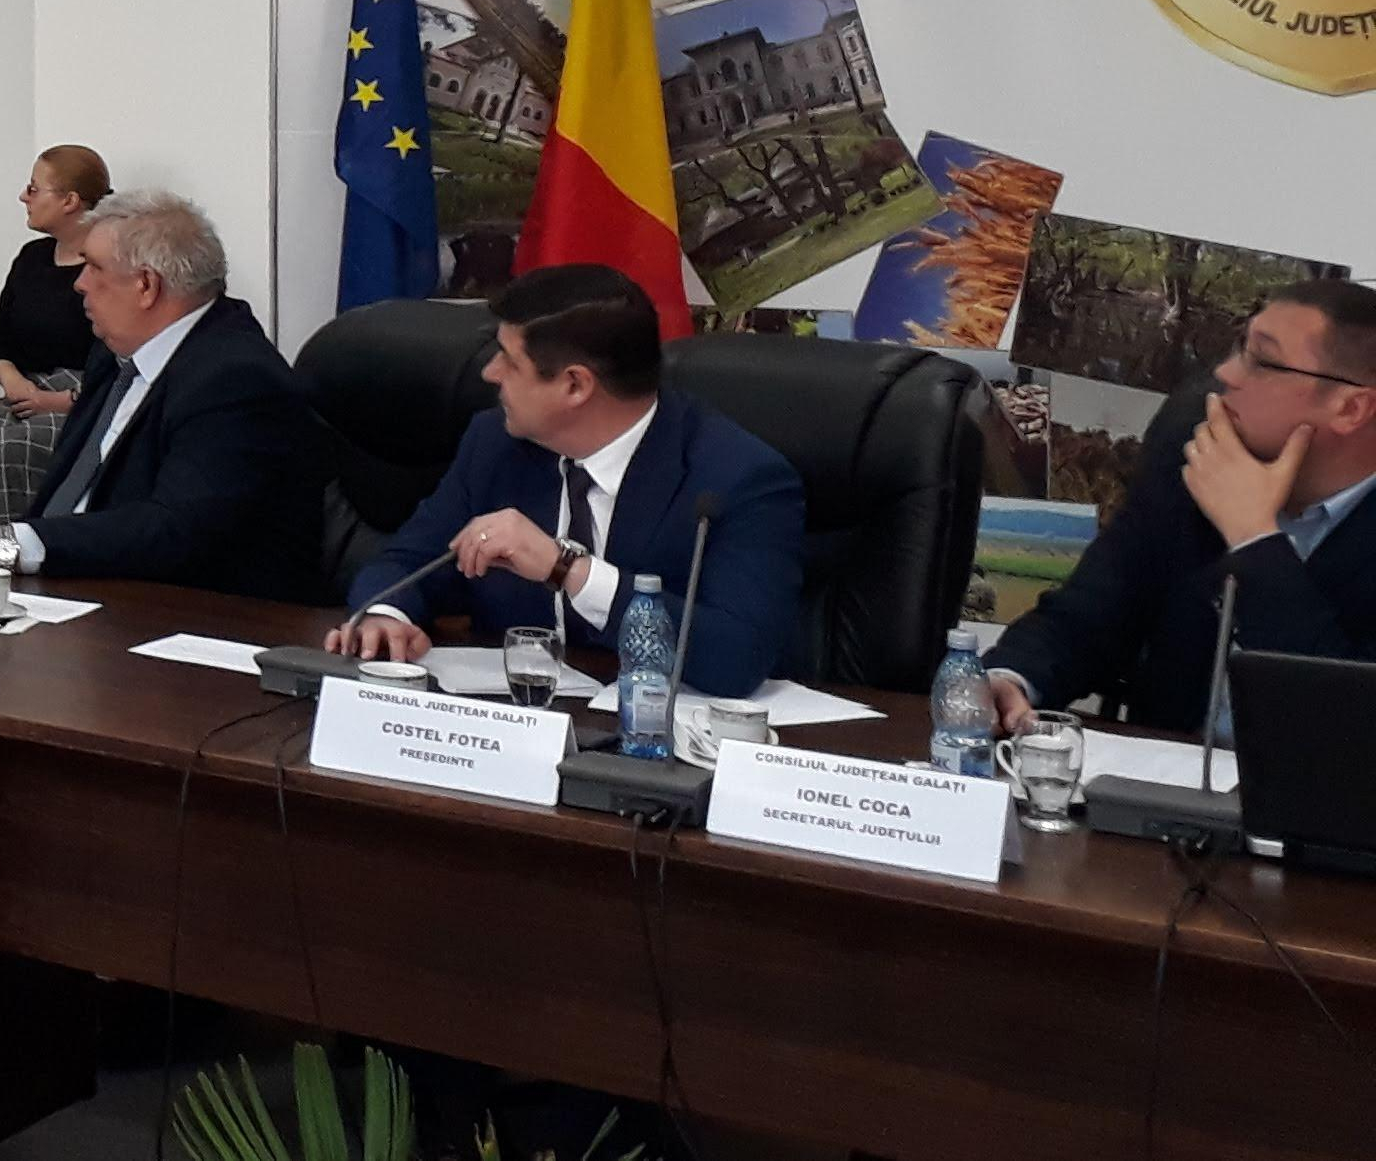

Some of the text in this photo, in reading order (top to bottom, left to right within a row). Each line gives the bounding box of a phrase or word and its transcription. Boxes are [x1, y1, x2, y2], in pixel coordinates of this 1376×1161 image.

[1286, 9, 1376, 40] JUDEȚ
[358, 689, 421, 708] CONSILIUL
[381, 721, 501, 752] COSTEL FOTEA
[755, 751, 828, 772] CONSILIUL
[796, 788, 912, 819] IONEL COCA
[762, 807, 854, 831] SECRETARUL
